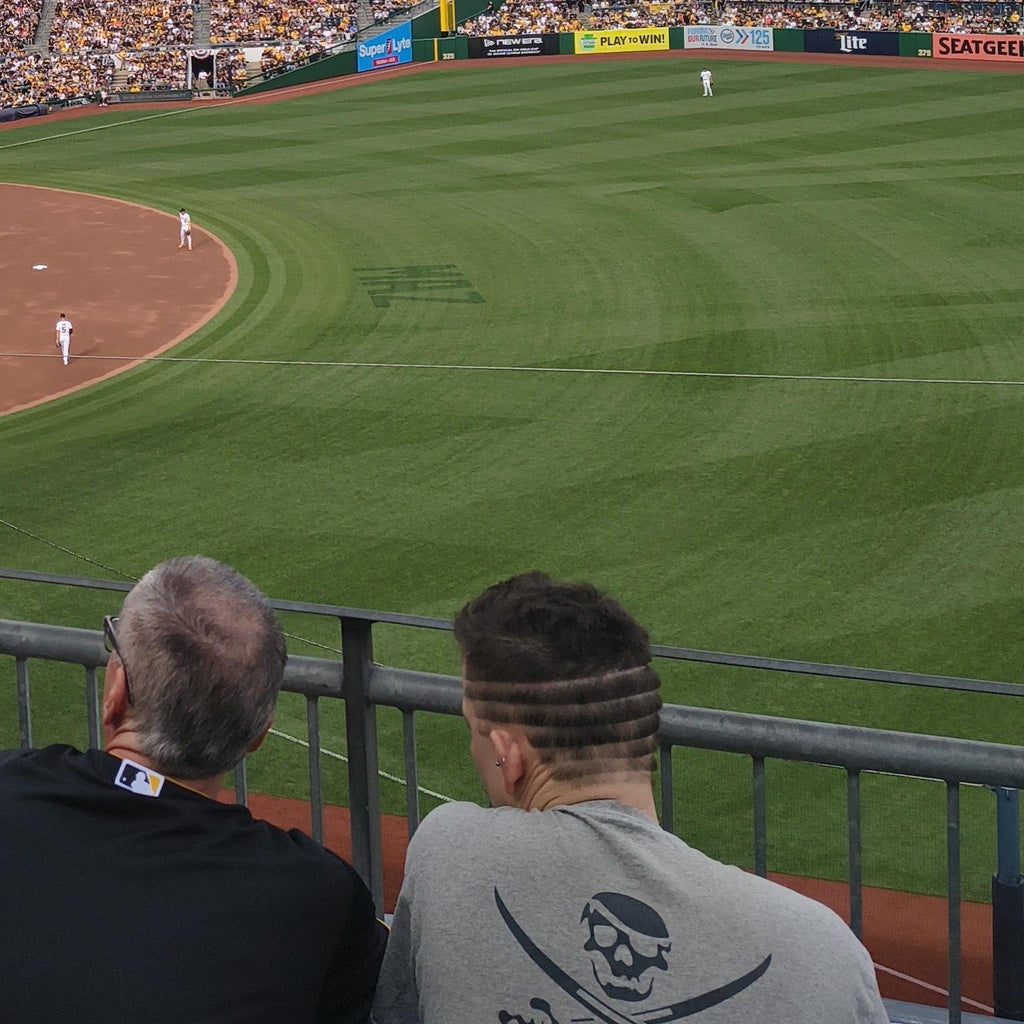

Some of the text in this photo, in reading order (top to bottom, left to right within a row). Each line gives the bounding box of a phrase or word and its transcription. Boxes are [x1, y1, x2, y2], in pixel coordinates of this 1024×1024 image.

[600, 36, 626, 46] PLAY
[639, 34, 665, 45] WIN!
[750, 30, 770, 44] 125
[840, 35, 867, 52] Lite
[359, 38, 411, 57] Super Lyte
